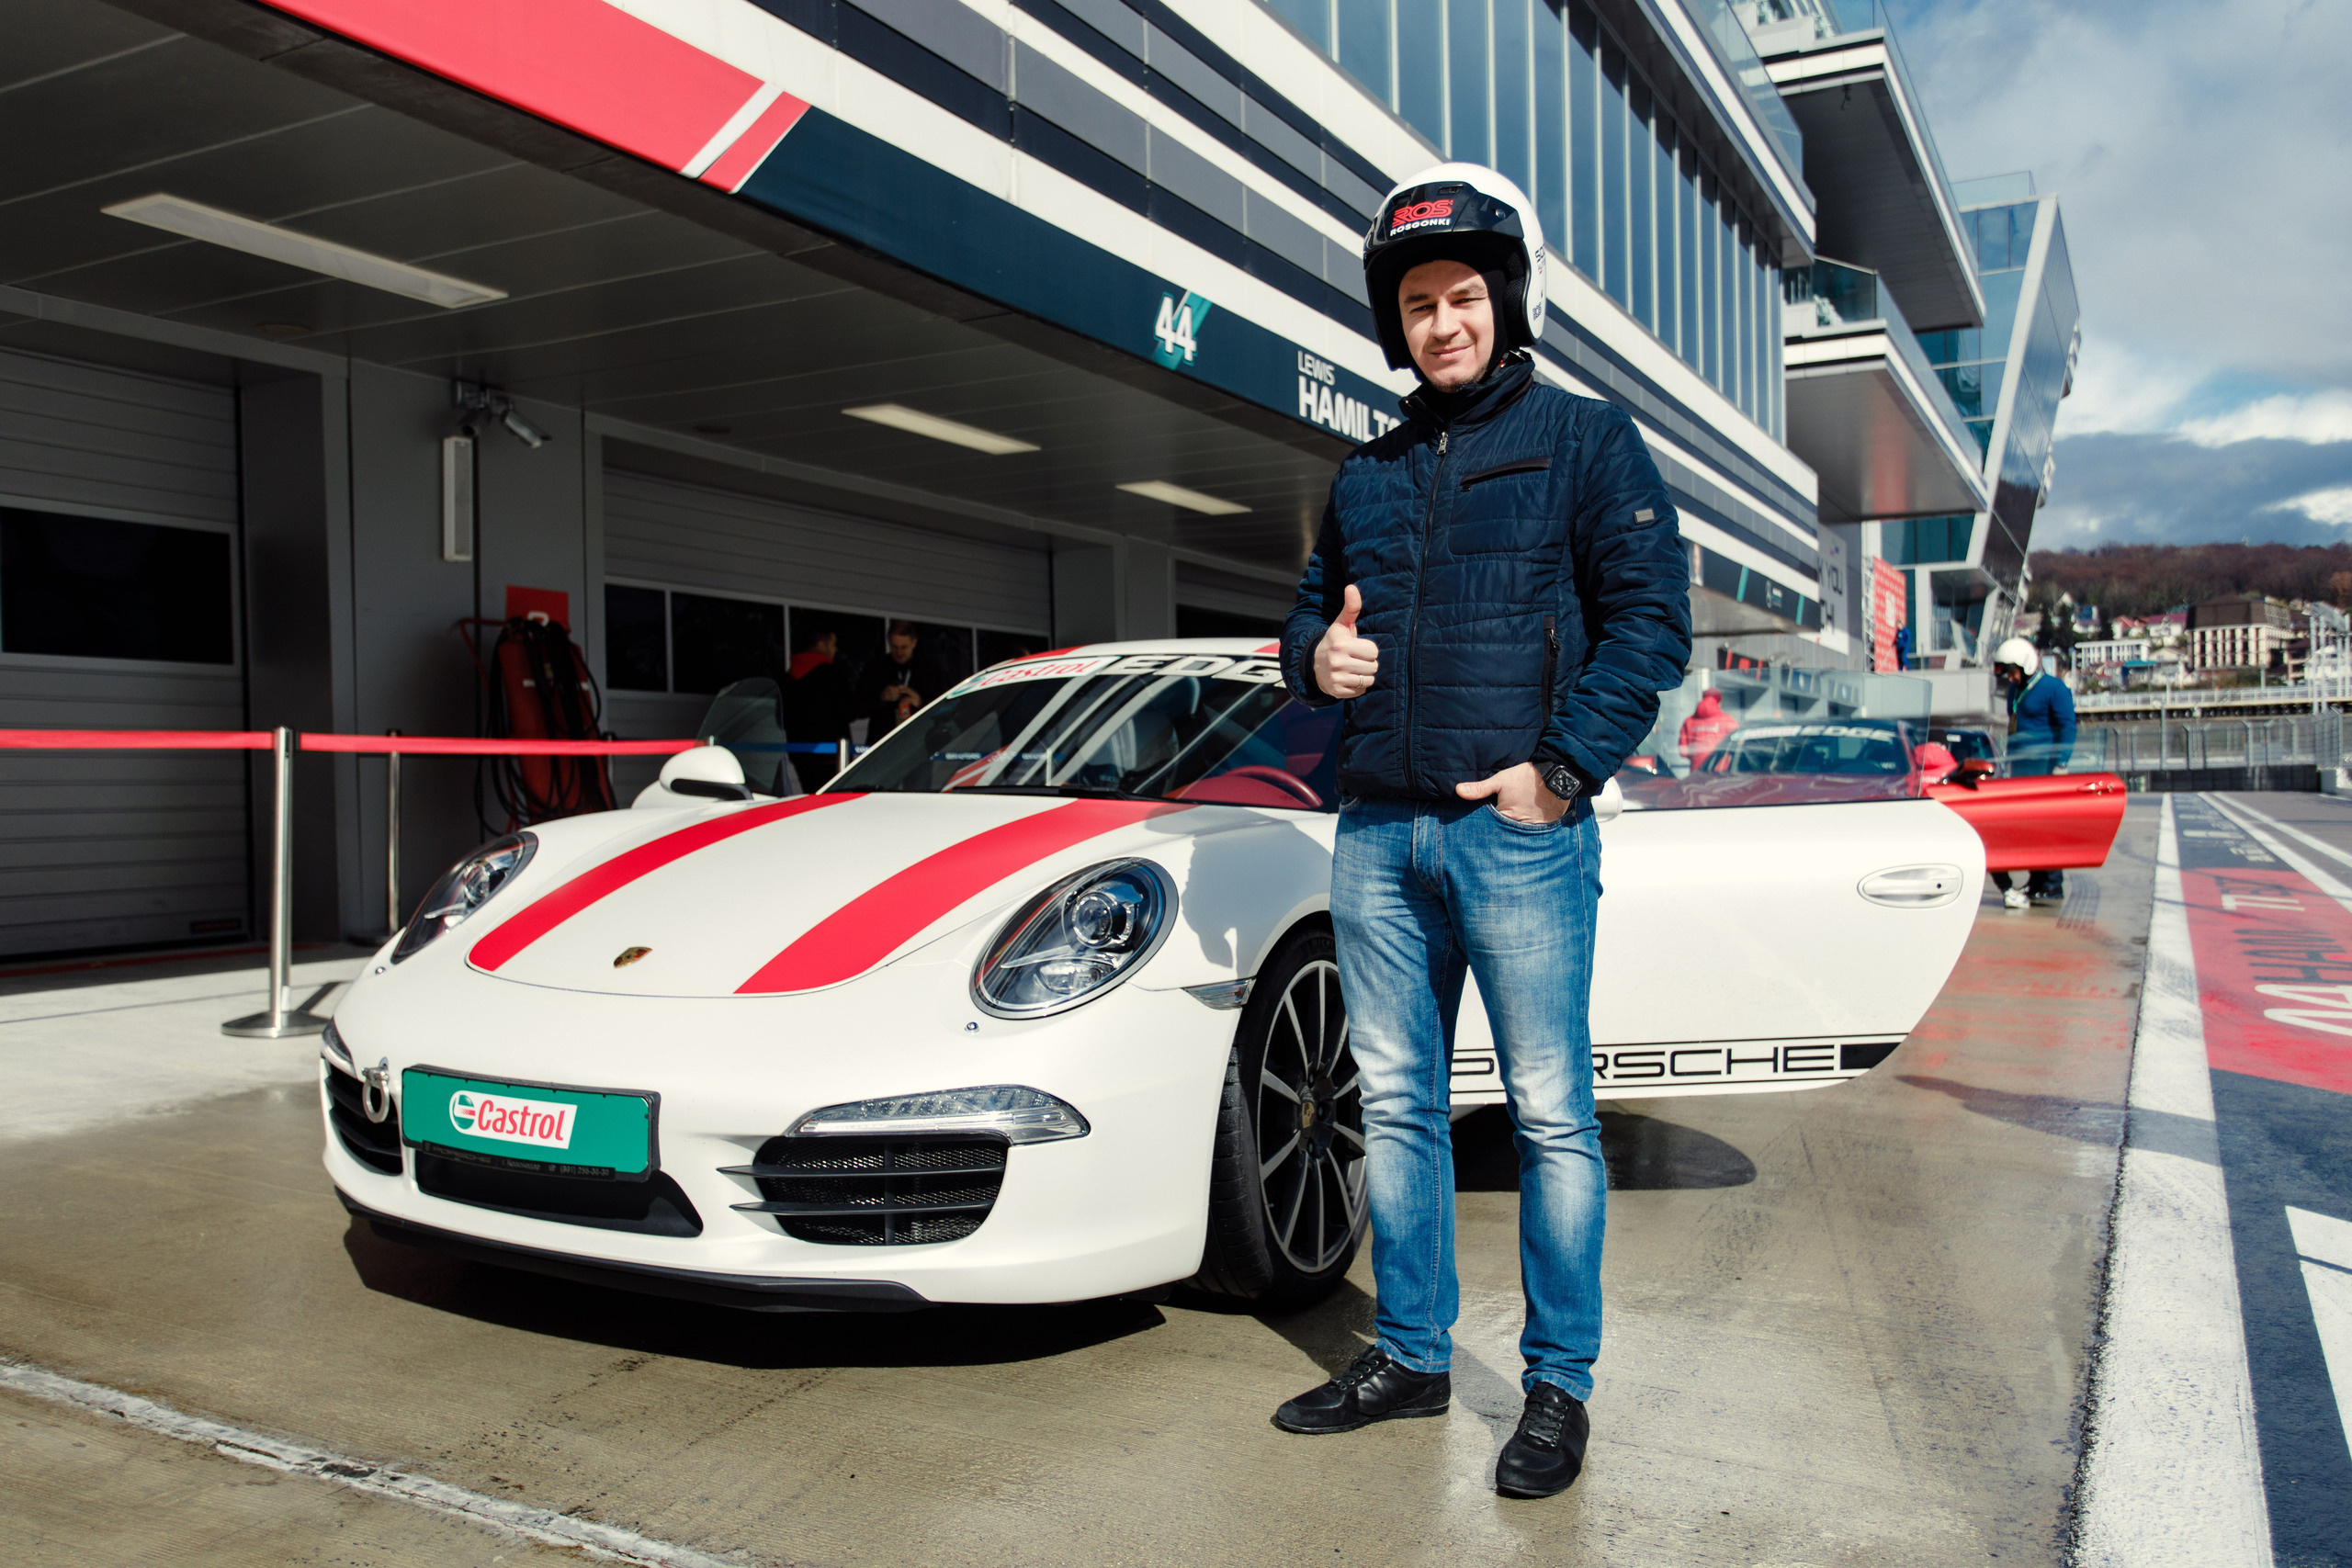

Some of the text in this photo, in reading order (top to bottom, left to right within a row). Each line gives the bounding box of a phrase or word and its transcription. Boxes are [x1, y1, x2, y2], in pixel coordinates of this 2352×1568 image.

[1389, 218, 1452, 237] ROSGONKI
[1391, 198, 1453, 229] ROS
[1155, 295, 1197, 363] 44
[1297, 350, 1336, 386] LEWIS
[979, 654, 1287, 688] Castrol EDG
[1451, 1044, 1836, 1080] PRSCHE
[477, 1099, 566, 1141] Castrol
